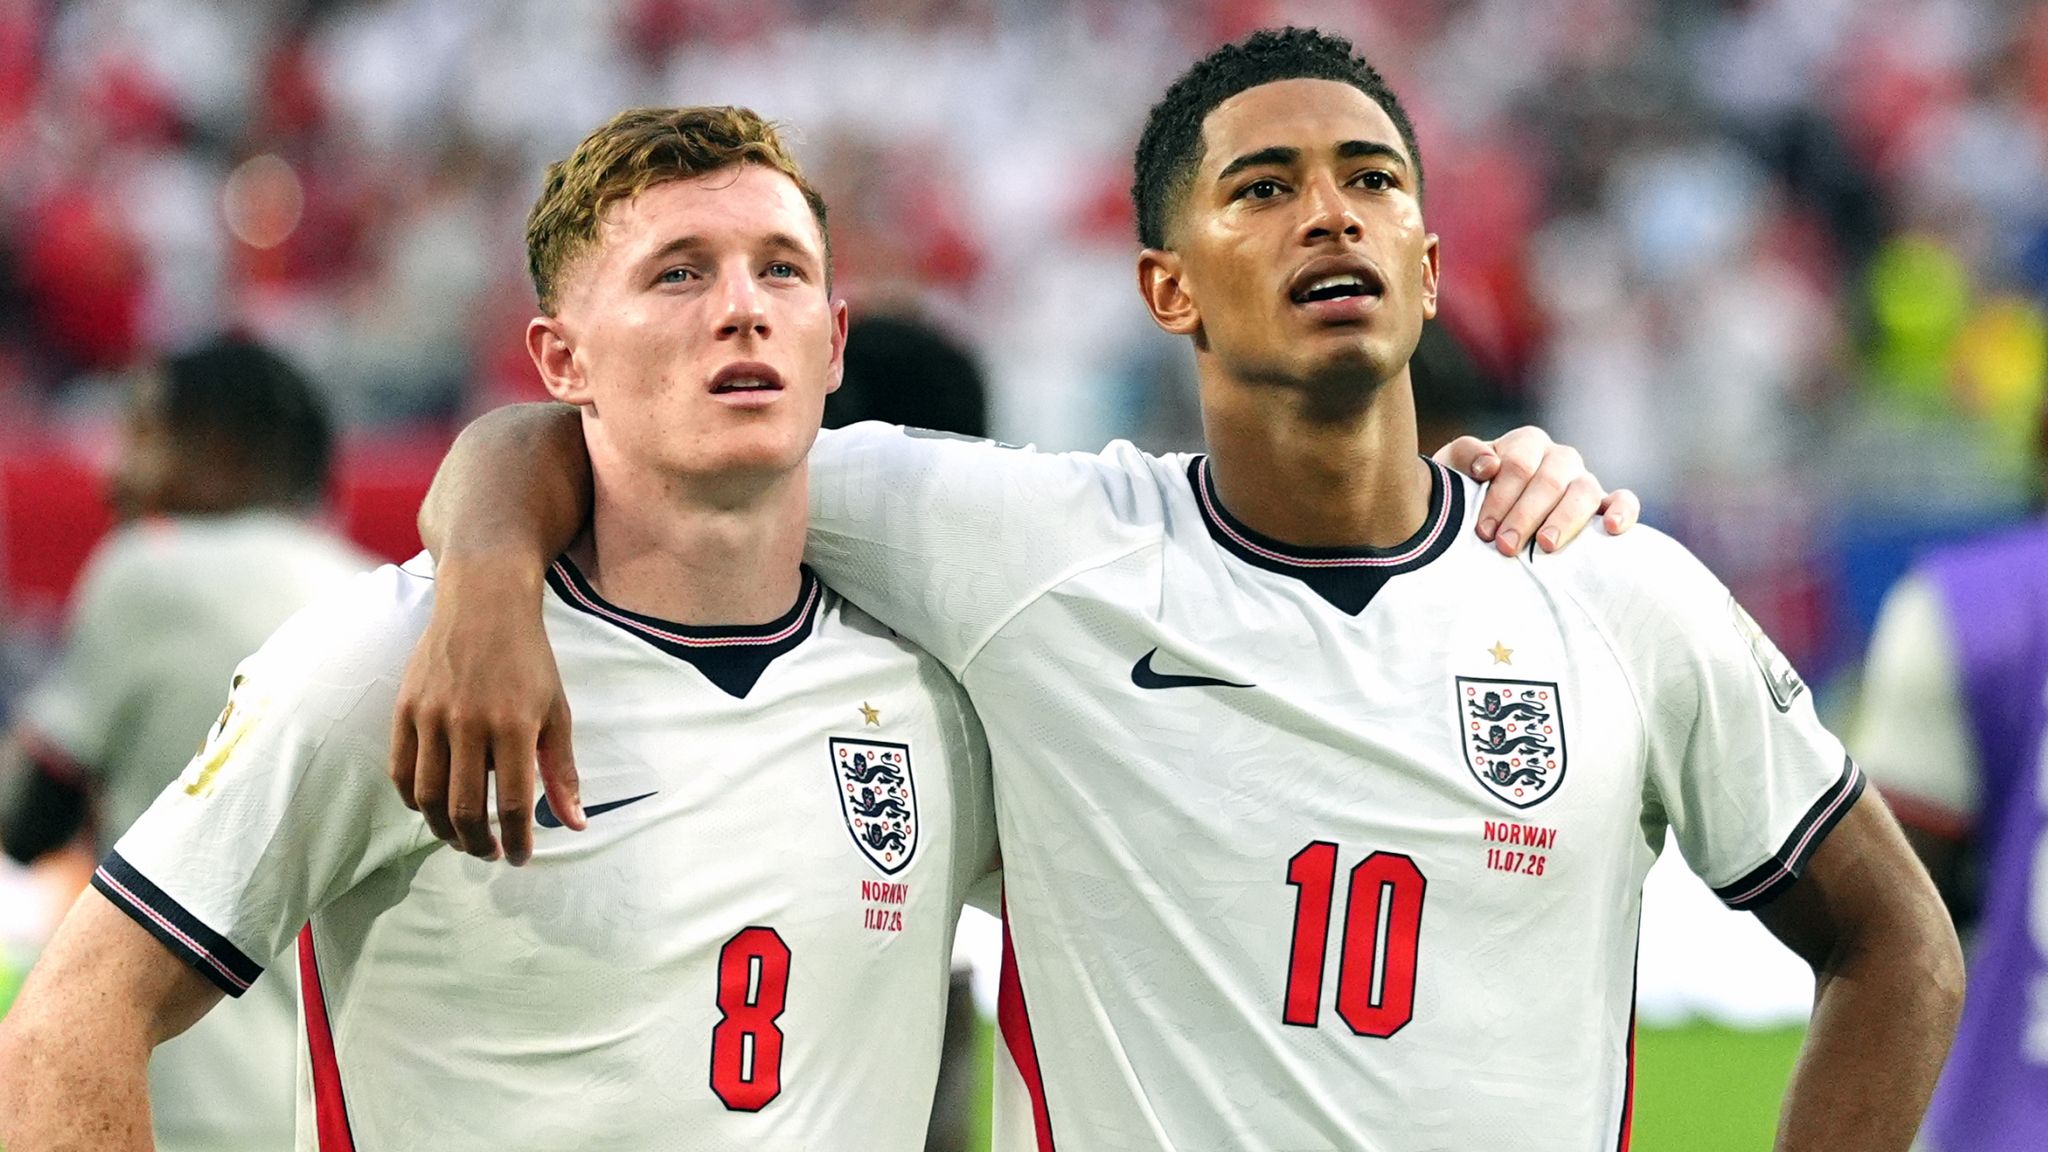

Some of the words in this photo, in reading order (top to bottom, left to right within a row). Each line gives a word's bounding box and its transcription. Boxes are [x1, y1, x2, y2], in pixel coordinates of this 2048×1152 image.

[1484, 821, 1556, 849] NORWAY
[1487, 849, 1546, 876] 11.07.26
[864, 908, 902, 931] 11.07.26
[1282, 840, 1427, 1039] 10
[709, 926, 791, 1113] 8
